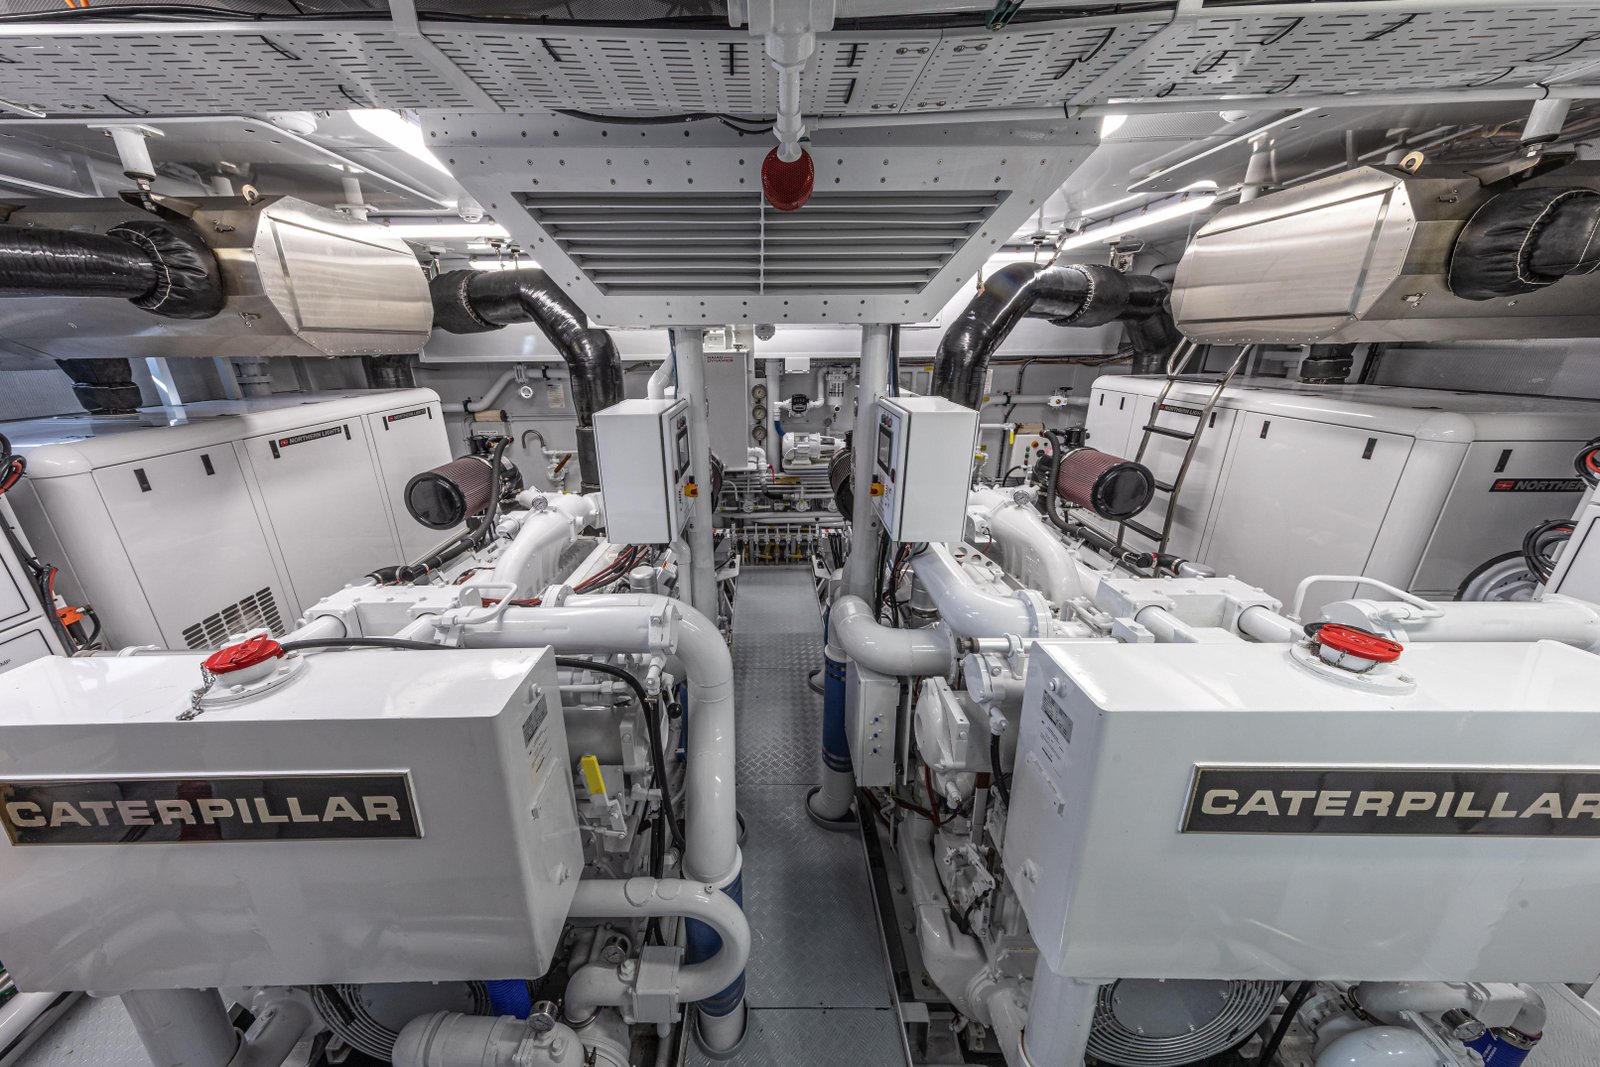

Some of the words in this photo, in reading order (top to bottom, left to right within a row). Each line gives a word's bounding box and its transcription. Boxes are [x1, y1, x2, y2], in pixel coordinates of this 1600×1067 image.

[289, 432, 321, 444] NORTHERN
[321, 427, 341, 437] LIGHTS
[1514, 480, 1587, 490] NORTHER
[5, 795, 401, 828] CATERPILLAR
[1201, 789, 1600, 819] CATERPILLAR
